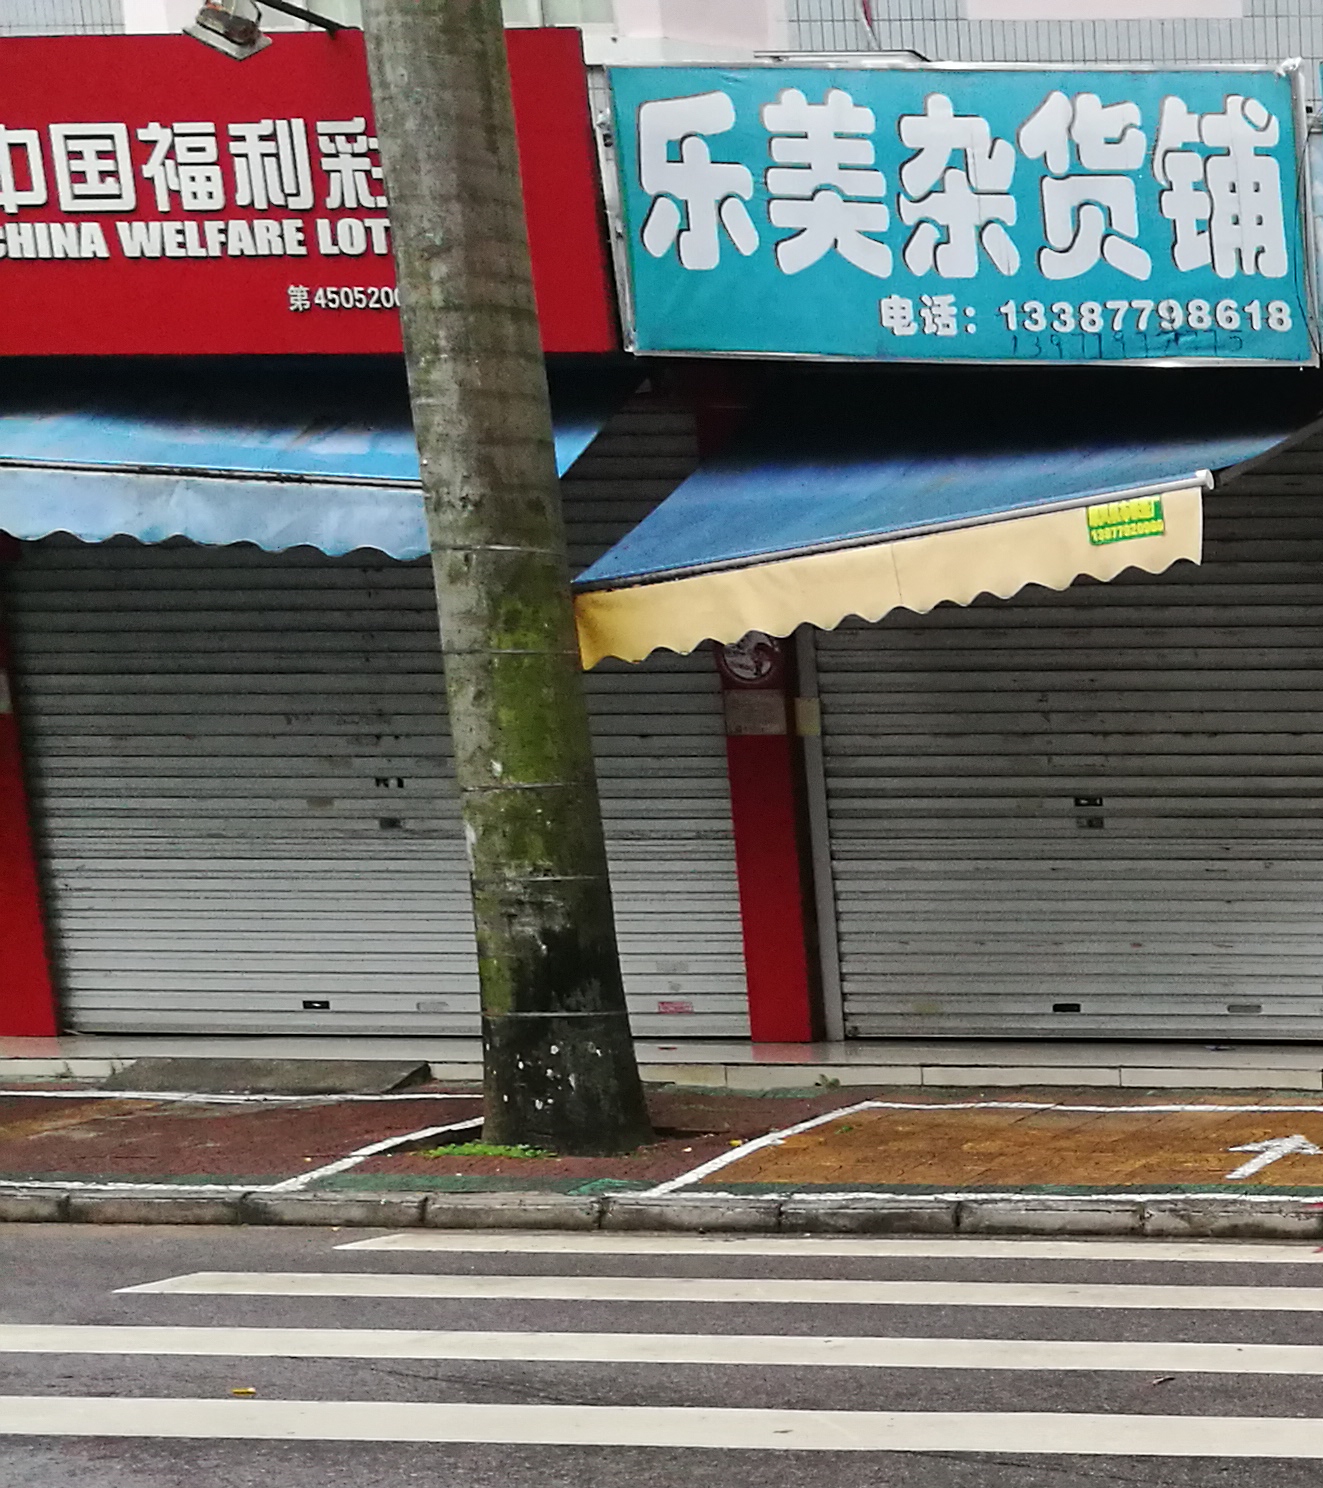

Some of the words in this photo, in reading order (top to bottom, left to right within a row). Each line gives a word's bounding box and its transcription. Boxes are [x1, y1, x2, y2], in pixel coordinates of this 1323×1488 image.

[637, 88, 1290, 281] 乐美杂货铺
[115, 219, 308, 257] WELFARE
[999, 298, 1293, 334] 13387798618
